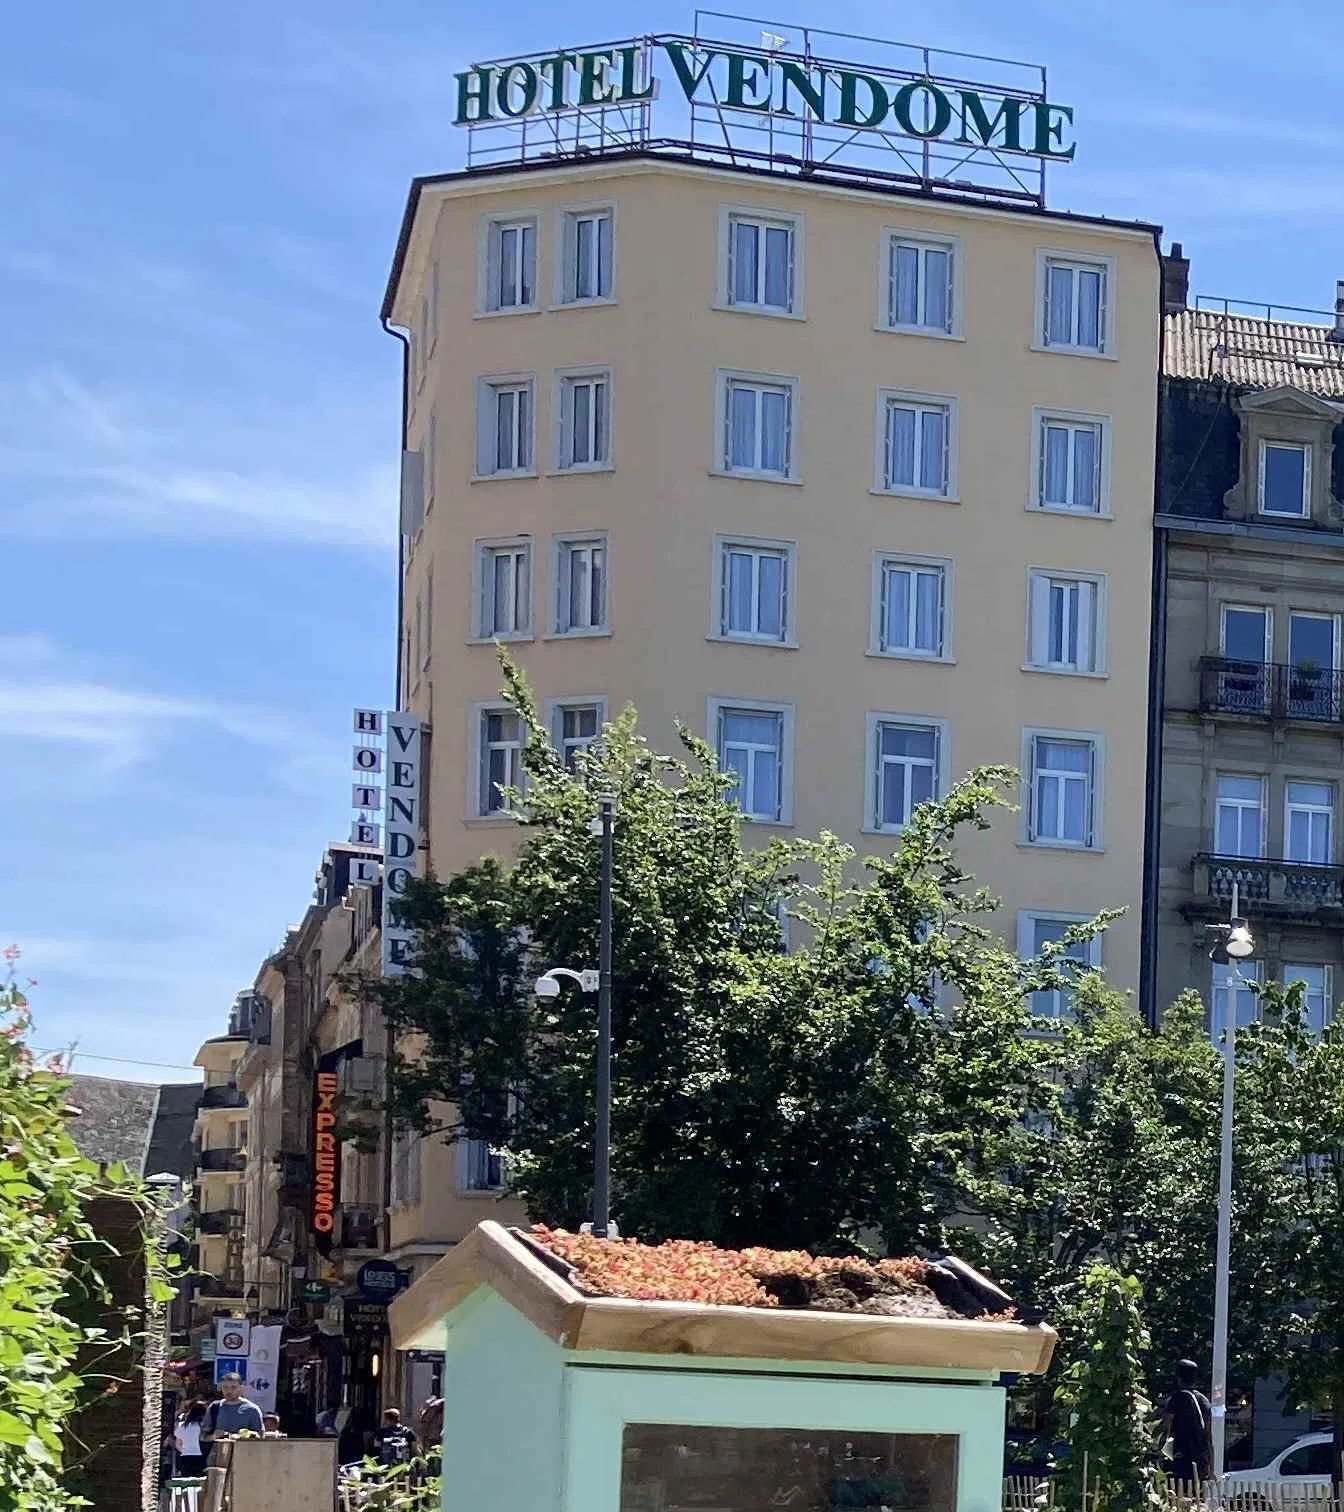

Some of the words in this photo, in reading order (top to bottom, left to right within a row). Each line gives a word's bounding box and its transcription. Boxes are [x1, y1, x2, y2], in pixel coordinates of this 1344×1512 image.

[454, 44, 658, 127] HOTEL
[663, 42, 1078, 161] VENDOME
[356, 712, 377, 881] HOTEL
[314, 1072, 338, 1233] EXPRESSO
